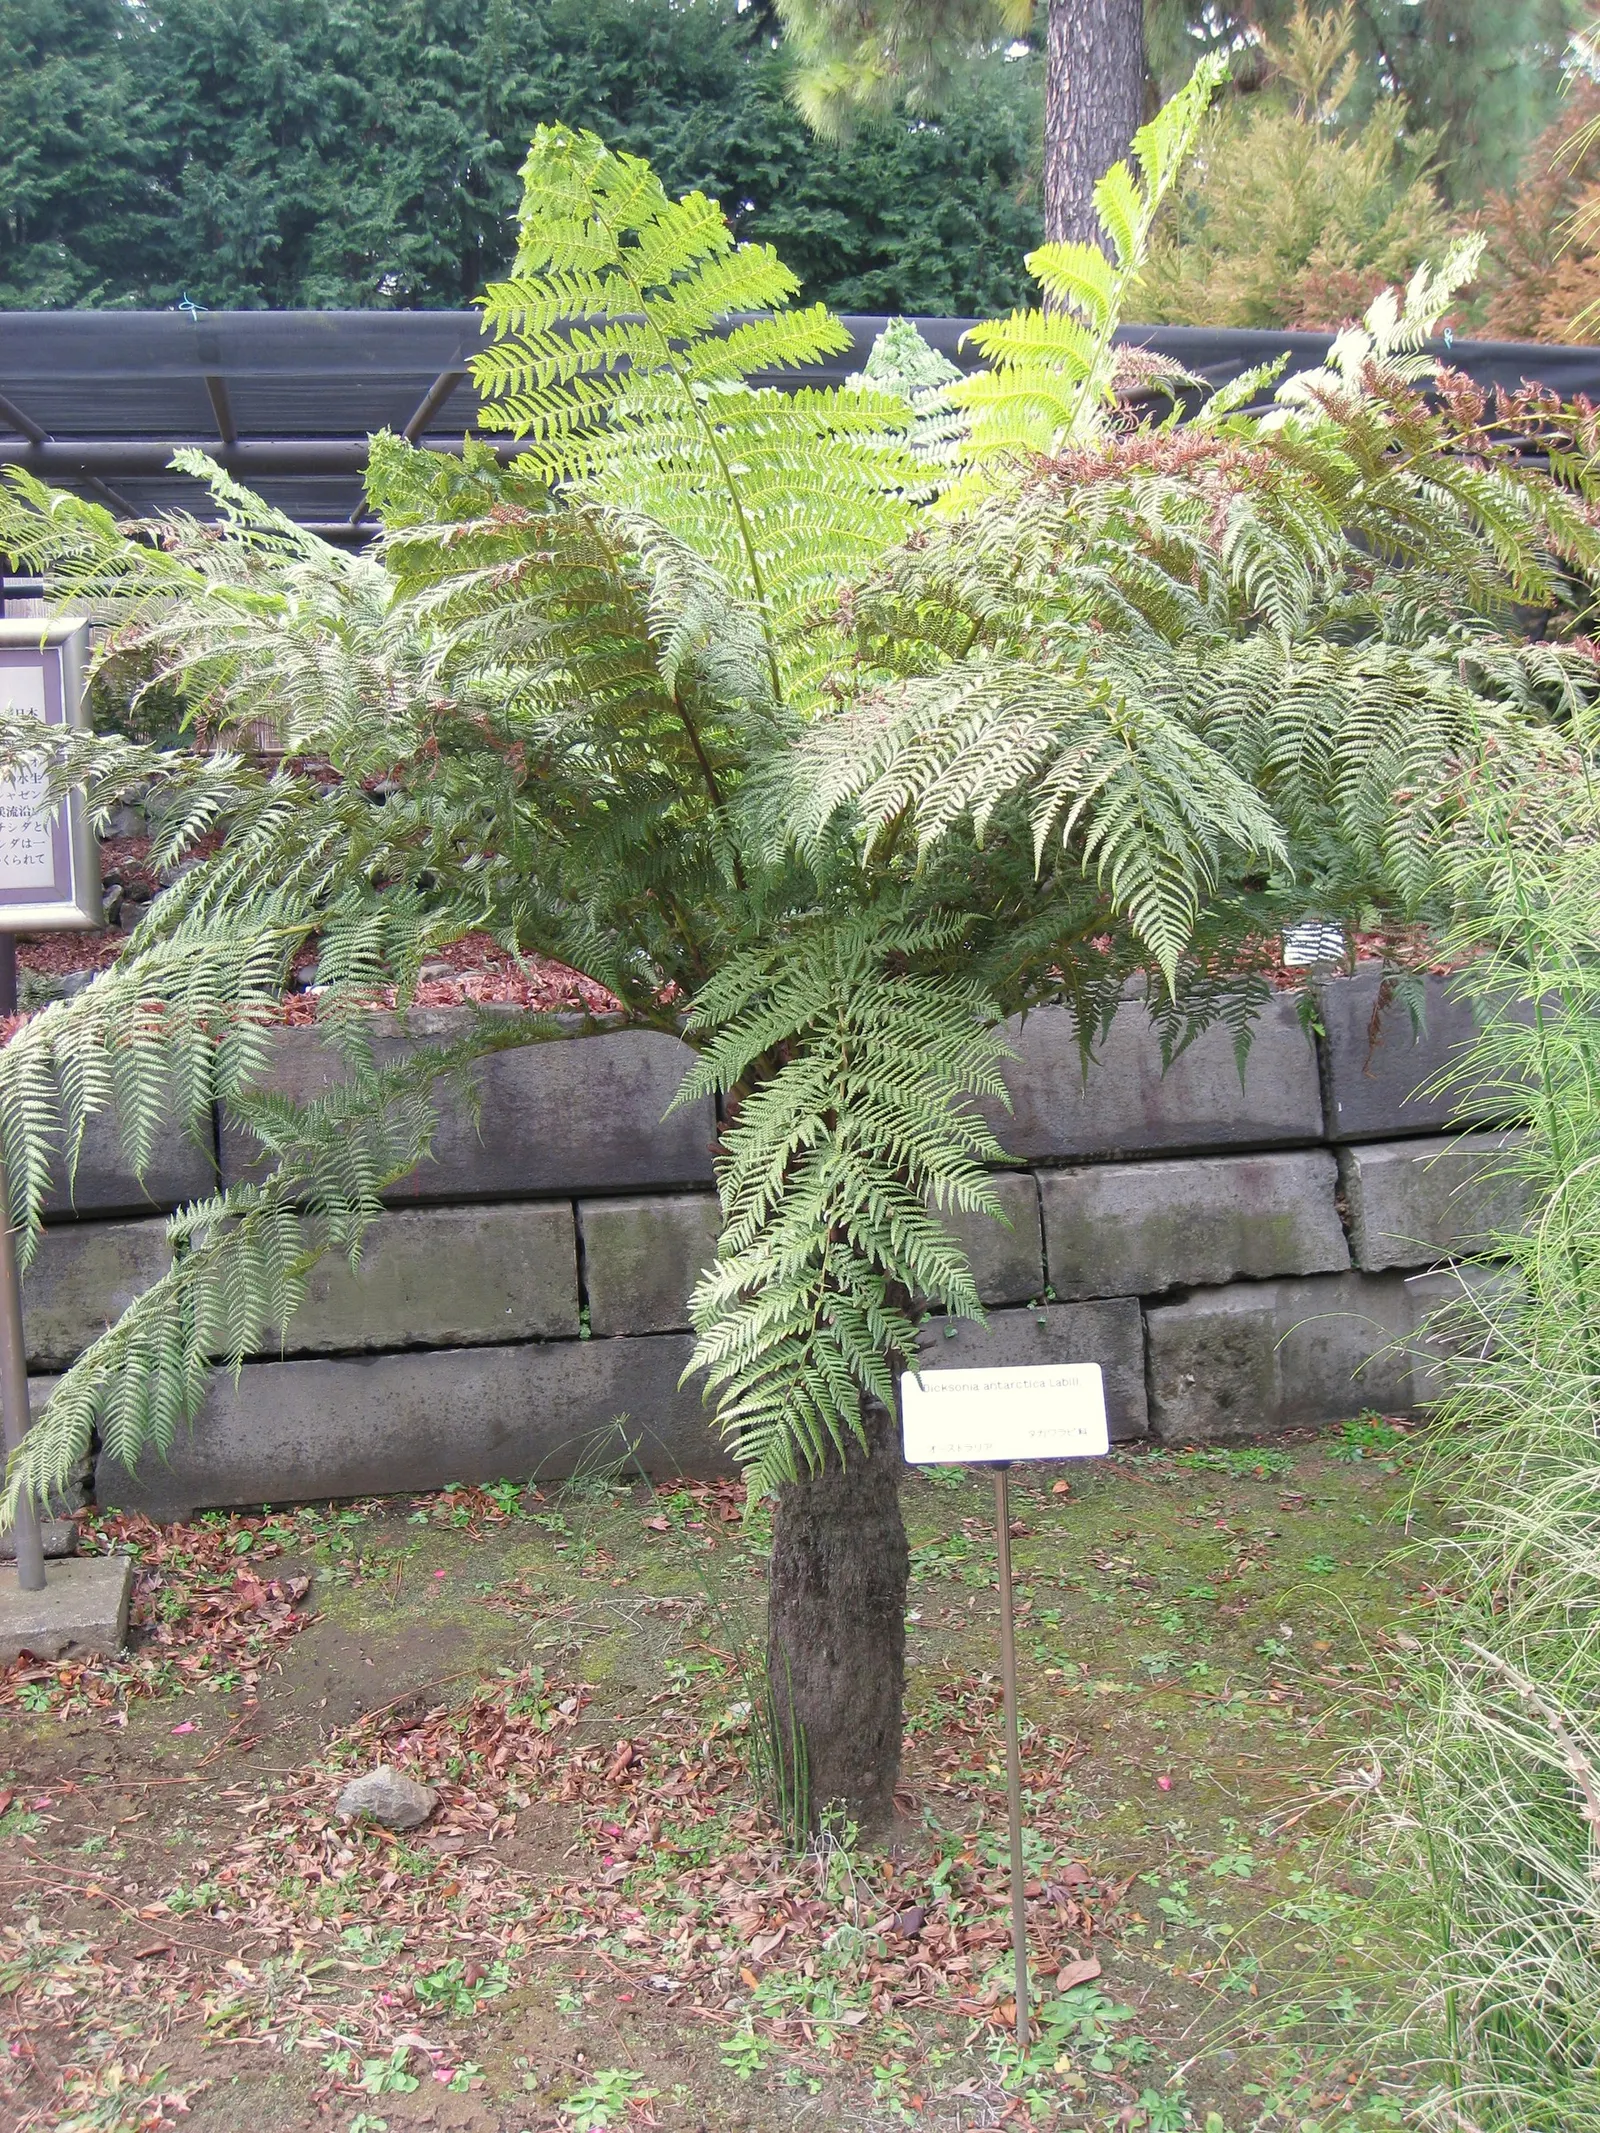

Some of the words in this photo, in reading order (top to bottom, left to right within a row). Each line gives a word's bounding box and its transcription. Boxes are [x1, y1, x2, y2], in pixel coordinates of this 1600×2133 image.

[0, 853, 45, 866] くられて
[923, 1383, 980, 1393] Dicksonia
[983, 1380, 1046, 1391] antarctica
